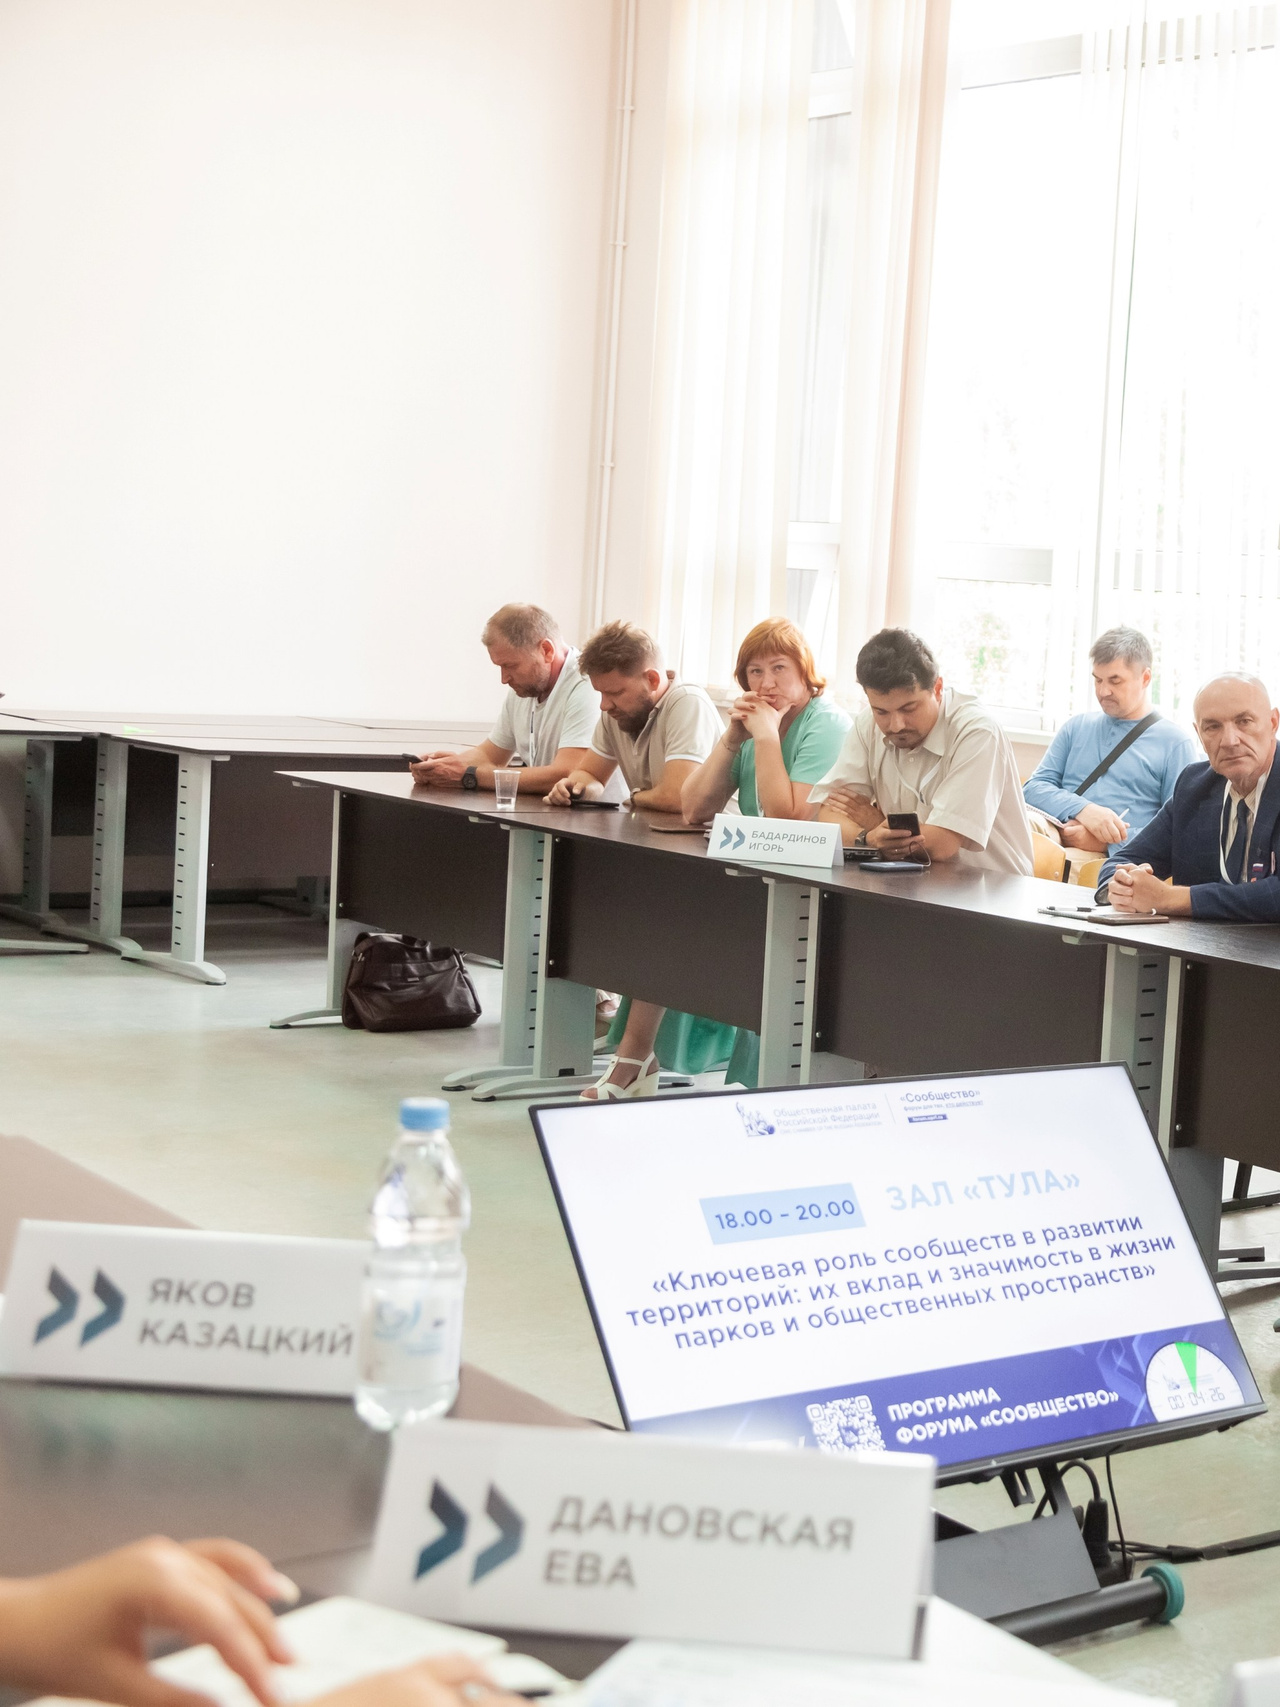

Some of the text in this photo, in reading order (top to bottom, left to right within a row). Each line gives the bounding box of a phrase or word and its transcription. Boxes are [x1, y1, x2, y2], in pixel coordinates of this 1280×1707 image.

[748, 842, 784, 852] ИГОРЬ
[751, 830, 827, 844] БАДАРДИНОВ
[773, 1102, 877, 1118] Общественная палата
[899, 1090, 981, 1103] «Сообщество»
[776, 1111, 880, 1127] Российской Федерации
[886, 1168, 1081, 1212] ЗАЛ «ТУЛА»
[715, 1208, 773, 1230] 18.00
[796, 1199, 856, 1222] 20.00
[652, 1216, 1144, 1293] «Ключевая роль сообществ в развитии
[149, 1277, 256, 1308] ЯКОВ
[626, 1236, 1176, 1327] территорий: их вклад и значимость в жизни
[674, 1264, 1156, 1350] парков и общественных пространств»
[138, 1318, 354, 1357] КАЗАЦКИЙ
[887, 1386, 1002, 1422] ПРОГРАММА
[895, 1388, 1120, 1445] ФОРУМА «СООБЩЕСТВО»
[549, 1496, 856, 1552] ДАНОВСКАЯ
[543, 1549, 637, 1588] ЕВА
